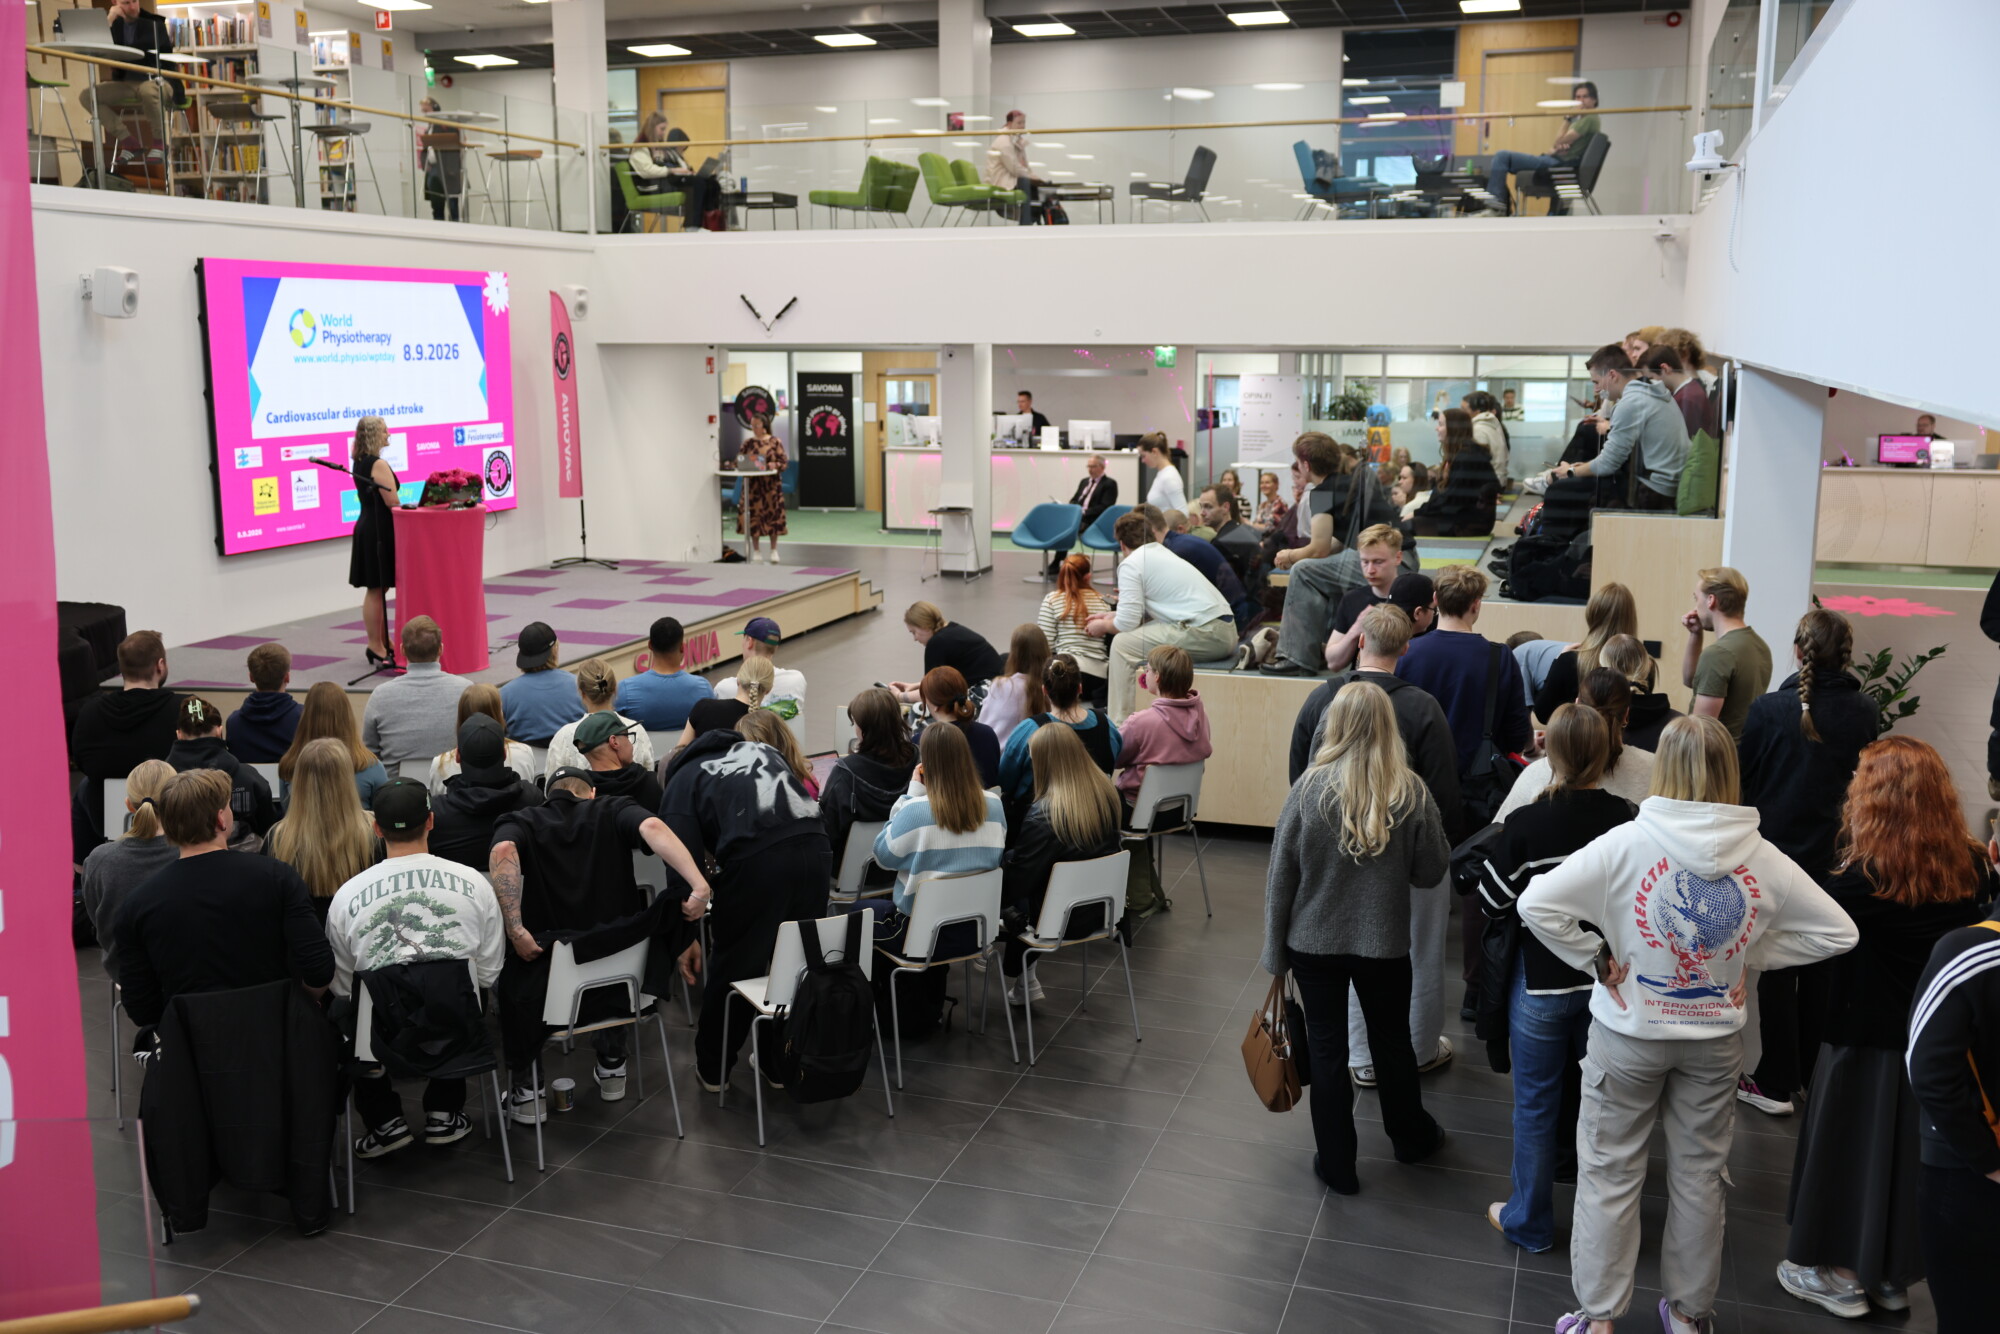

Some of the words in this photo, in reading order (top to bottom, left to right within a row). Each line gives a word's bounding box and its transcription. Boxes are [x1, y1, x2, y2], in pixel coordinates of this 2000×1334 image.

[320, 314, 352, 327] World
[322, 330, 392, 347] Physiotherapy
[403, 343, 459, 361] 8.9.2026
[806, 384, 844, 393] SAVONIA
[266, 408, 340, 424] Cardiovascular
[342, 407, 377, 418] disease
[378, 404, 395, 416] and
[397, 402, 424, 414] stroke
[416, 442, 440, 452] SAVONIA
[634, 630, 721, 674] SONIA
[349, 868, 475, 919] CULTIVATE
[1634, 857, 1670, 949] STRENGTH
[1725, 907, 1758, 962] MUSIC
[1644, 999, 1734, 1010] INTERNATIONA
[1661, 1008, 1722, 1017] RECORDS
